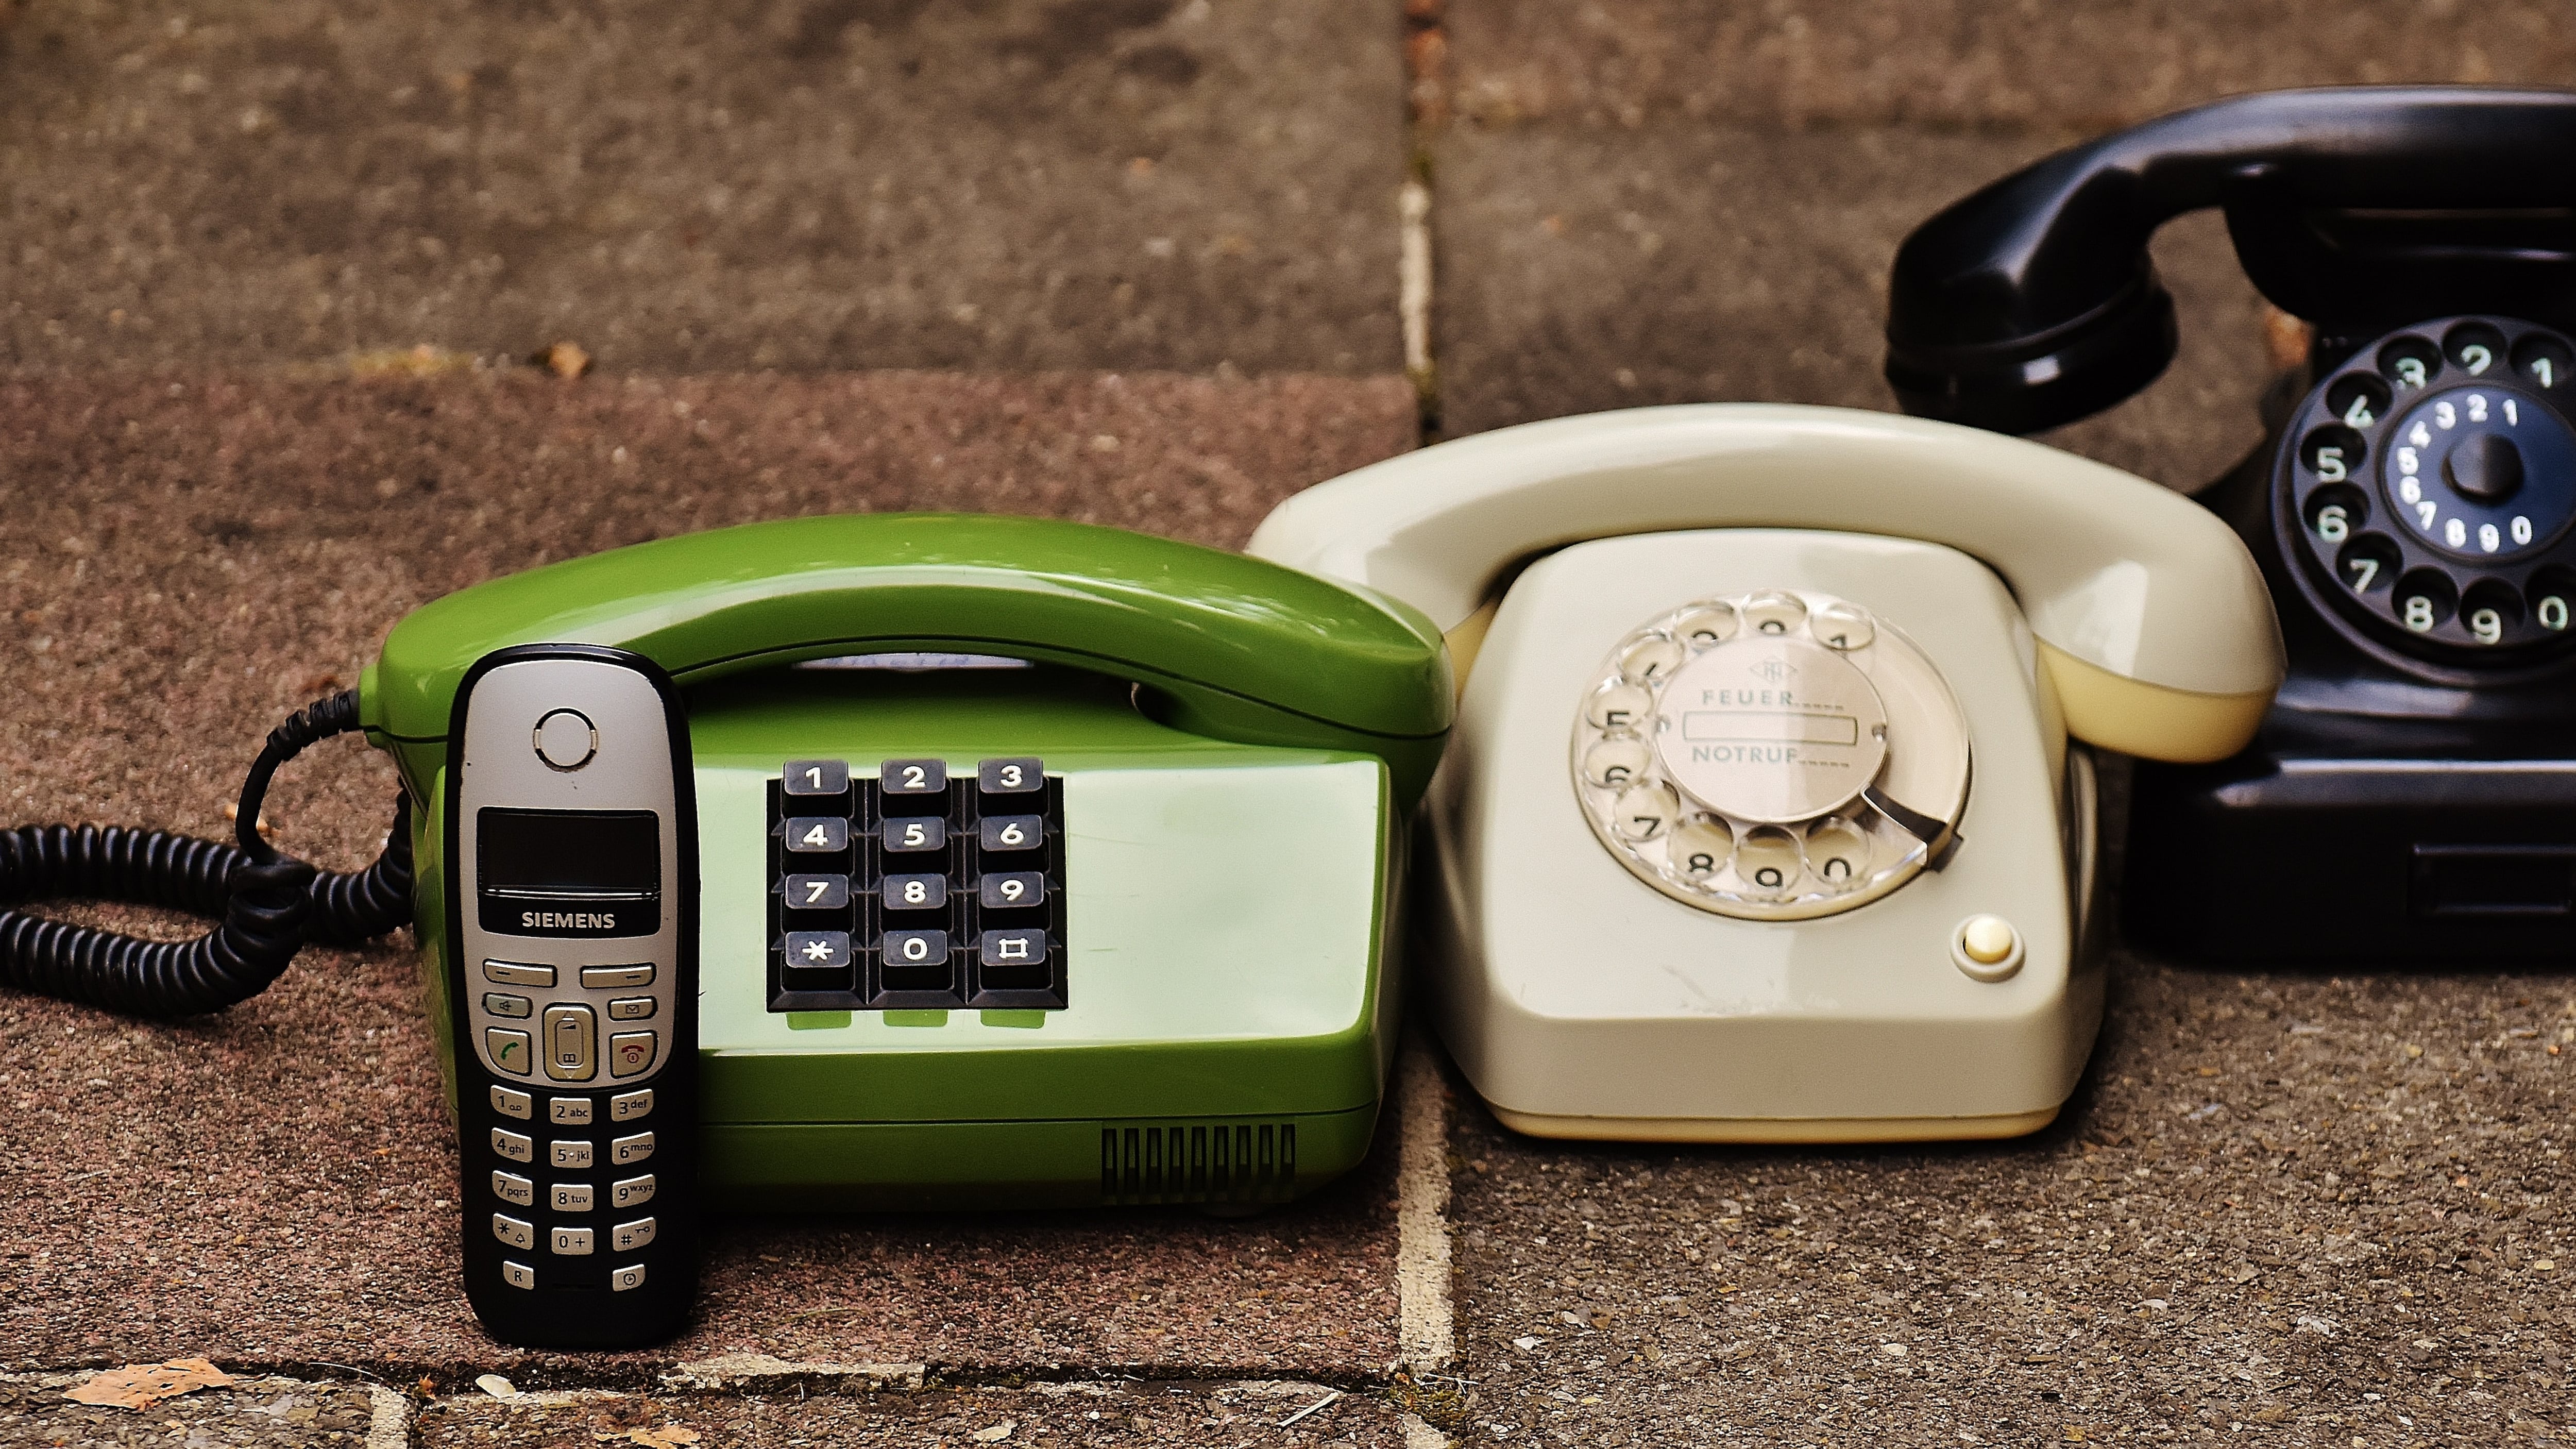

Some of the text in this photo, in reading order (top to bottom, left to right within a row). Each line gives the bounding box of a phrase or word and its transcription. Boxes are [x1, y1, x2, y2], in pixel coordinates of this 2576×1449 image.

[2532, 357, 2553, 389] 1
[2434, 401, 2456, 430] 3
[2466, 393, 2488, 422] 2
[2502, 399, 2518, 427] 1
[2409, 420, 2432, 449] 4
[2317, 446, 2347, 483] 5
[2397, 446, 2419, 475] 5
[2399, 476, 2421, 505] 6
[2317, 505, 2349, 544] 6
[2416, 500, 2437, 531] 7
[2445, 518, 2466, 548] 8
[2478, 524, 2500, 553] 9
[2511, 515, 2533, 545] 0
[2350, 559, 2379, 594] 7
[2404, 596, 2434, 633] 8
[2538, 596, 2568, 631] 0
[2471, 608, 2502, 645] 9
[1702, 689, 1793, 706] FEUER
[1692, 746, 1798, 764] NOTRUF
[805, 767, 821, 788] 1
[902, 766, 925, 788] 2
[1001, 765, 1023, 788] 3
[803, 824, 828, 846] 4
[904, 823, 926, 846] 5
[1000, 823, 1025, 845] 6
[806, 882, 828, 903] 7
[903, 881, 926, 903] 8
[1000, 880, 1024, 901] 9
[521, 911, 615, 929] SIEMENS
[498, 1095, 505, 1107] 1
[556, 1105, 588, 1118] 2 abc
[619, 1099, 648, 1114] 3 def
[497, 1138, 524, 1155] 4 ghi
[558, 1149, 589, 1161] 5 jkl
[620, 1146, 629, 1159] 6
[498, 1180, 528, 1198] 7 pqrs
[558, 1192, 588, 1205] 8 tuv
[619, 1188, 629, 1200] 9
[559, 1236, 568, 1248] 0
[621, 1234, 632, 1245] #
[514, 1270, 522, 1282] R
